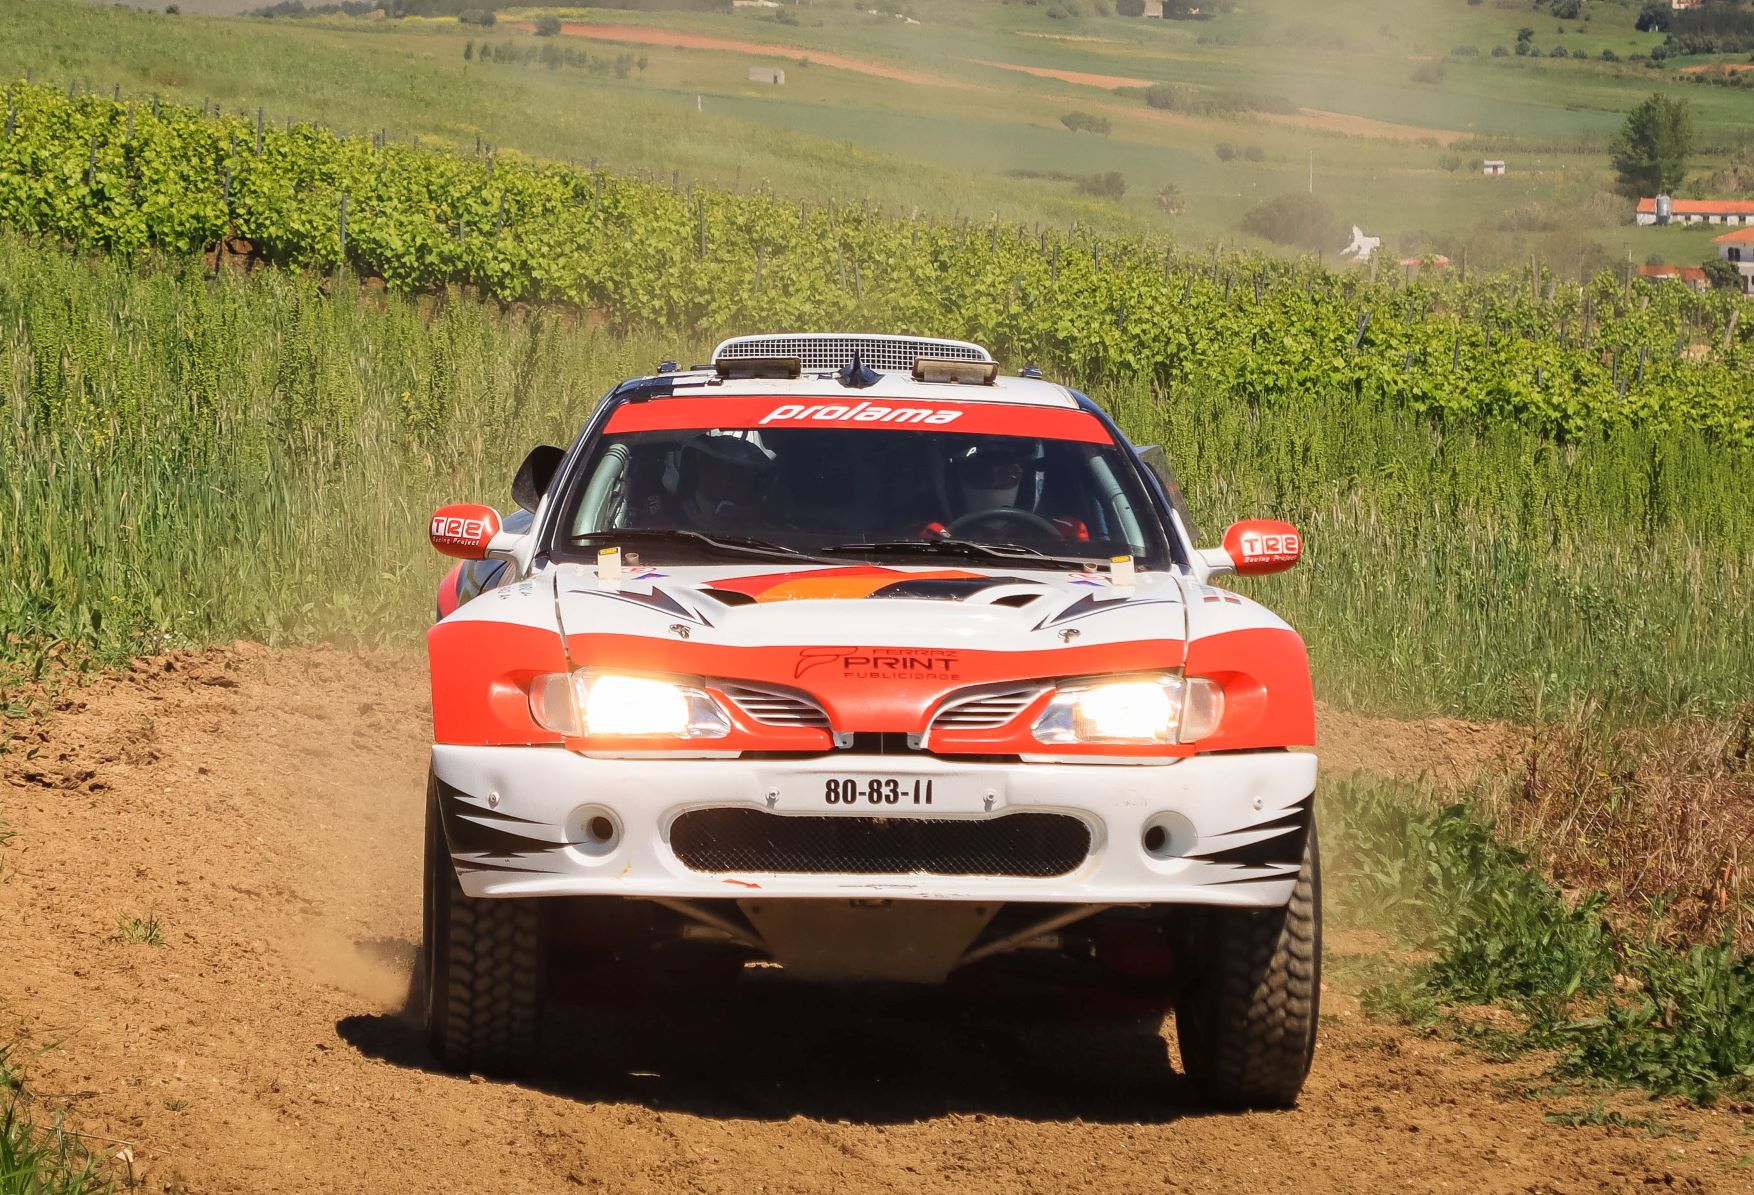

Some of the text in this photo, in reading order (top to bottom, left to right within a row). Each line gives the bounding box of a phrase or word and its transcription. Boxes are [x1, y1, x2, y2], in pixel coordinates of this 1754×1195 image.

[758, 402, 963, 424] prolama
[453, 538, 480, 546] Project
[872, 649, 958, 657] FERRAZ
[844, 656, 960, 671] PRINT
[844, 672, 960, 681] PUBLICIDADE
